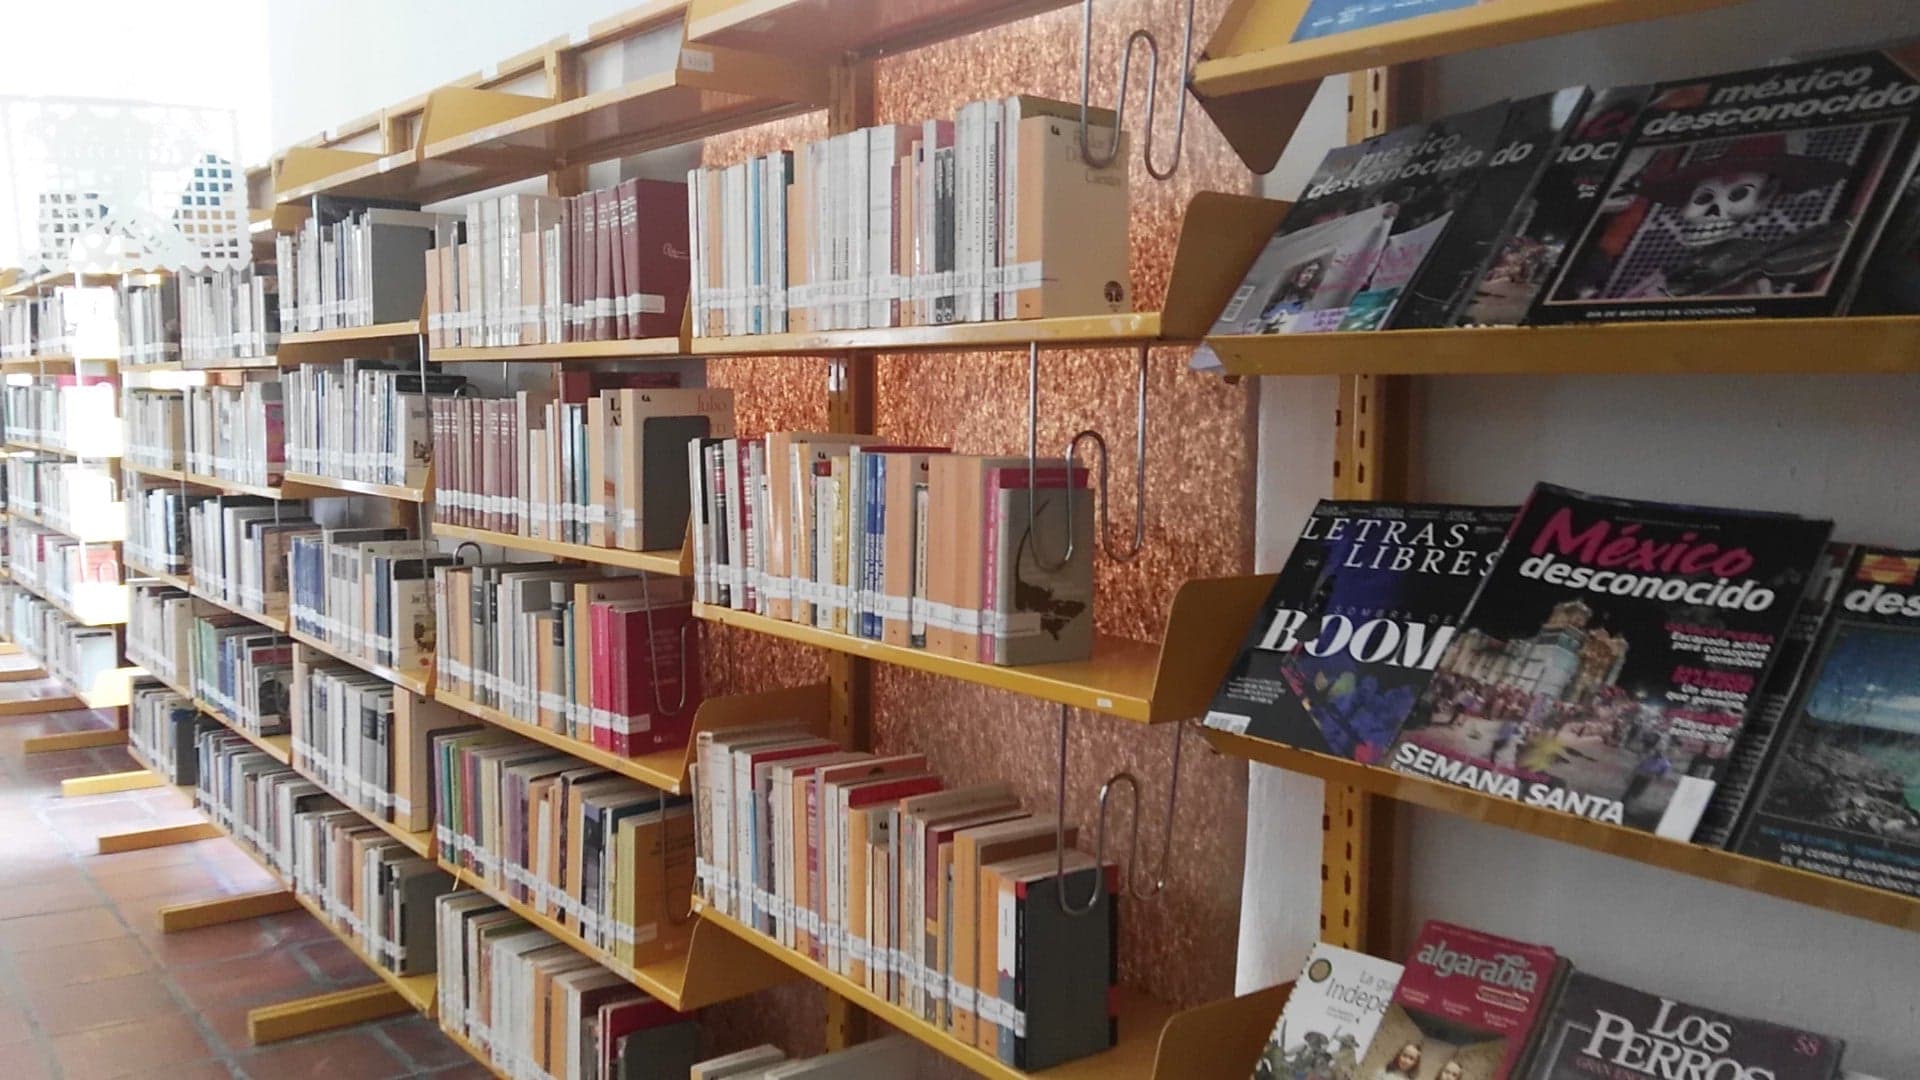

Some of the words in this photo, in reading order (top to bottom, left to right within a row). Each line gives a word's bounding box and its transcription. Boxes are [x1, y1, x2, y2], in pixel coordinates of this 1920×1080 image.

[1643, 81, 1920, 136] desconocido
[1712, 65, 1873, 104] méxico
[1301, 516, 1469, 548] LETRAS
[1530, 506, 1755, 578] México
[1518, 553, 1775, 612] desconocido
[1253, 608, 1457, 671] BOOM
[1395, 741, 1521, 801] SEMANA
[1524, 782, 1625, 826] SANTA
[1647, 998, 1733, 1054] LOS
